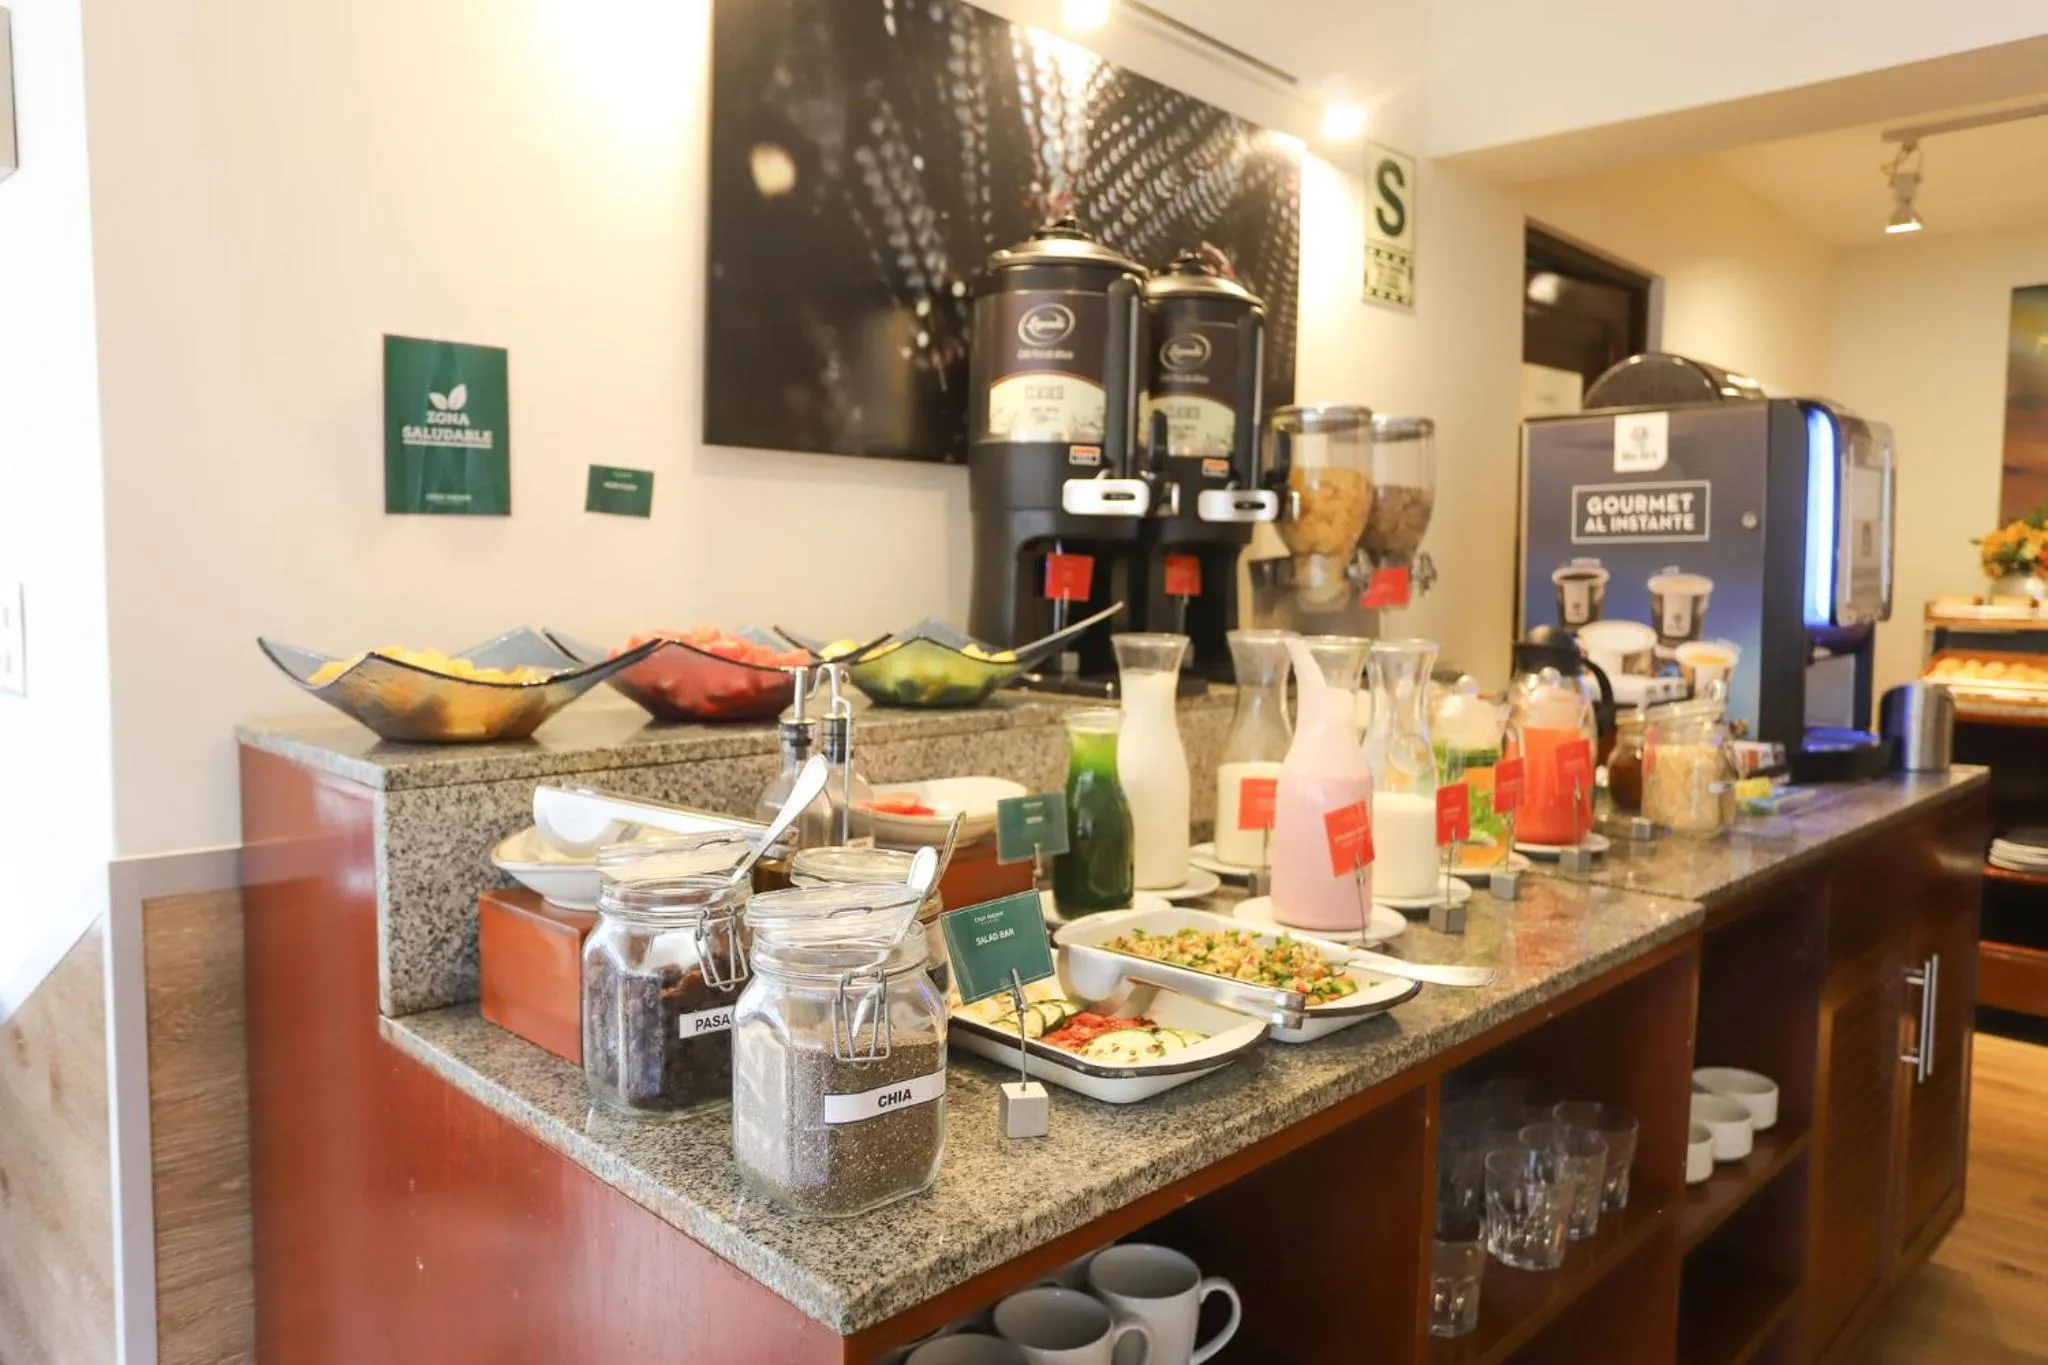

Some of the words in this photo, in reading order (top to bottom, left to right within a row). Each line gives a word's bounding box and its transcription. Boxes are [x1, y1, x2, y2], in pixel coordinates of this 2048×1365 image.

[1376, 158, 1406, 237] S
[426, 409, 470, 426] ZONA
[402, 425, 493, 444] SALUDABLE
[1586, 492, 1695, 515] GOURMET
[1584, 518, 1607, 534] AL
[1610, 513, 1695, 533] INSTANTE
[878, 1088, 913, 1108] CHIA
